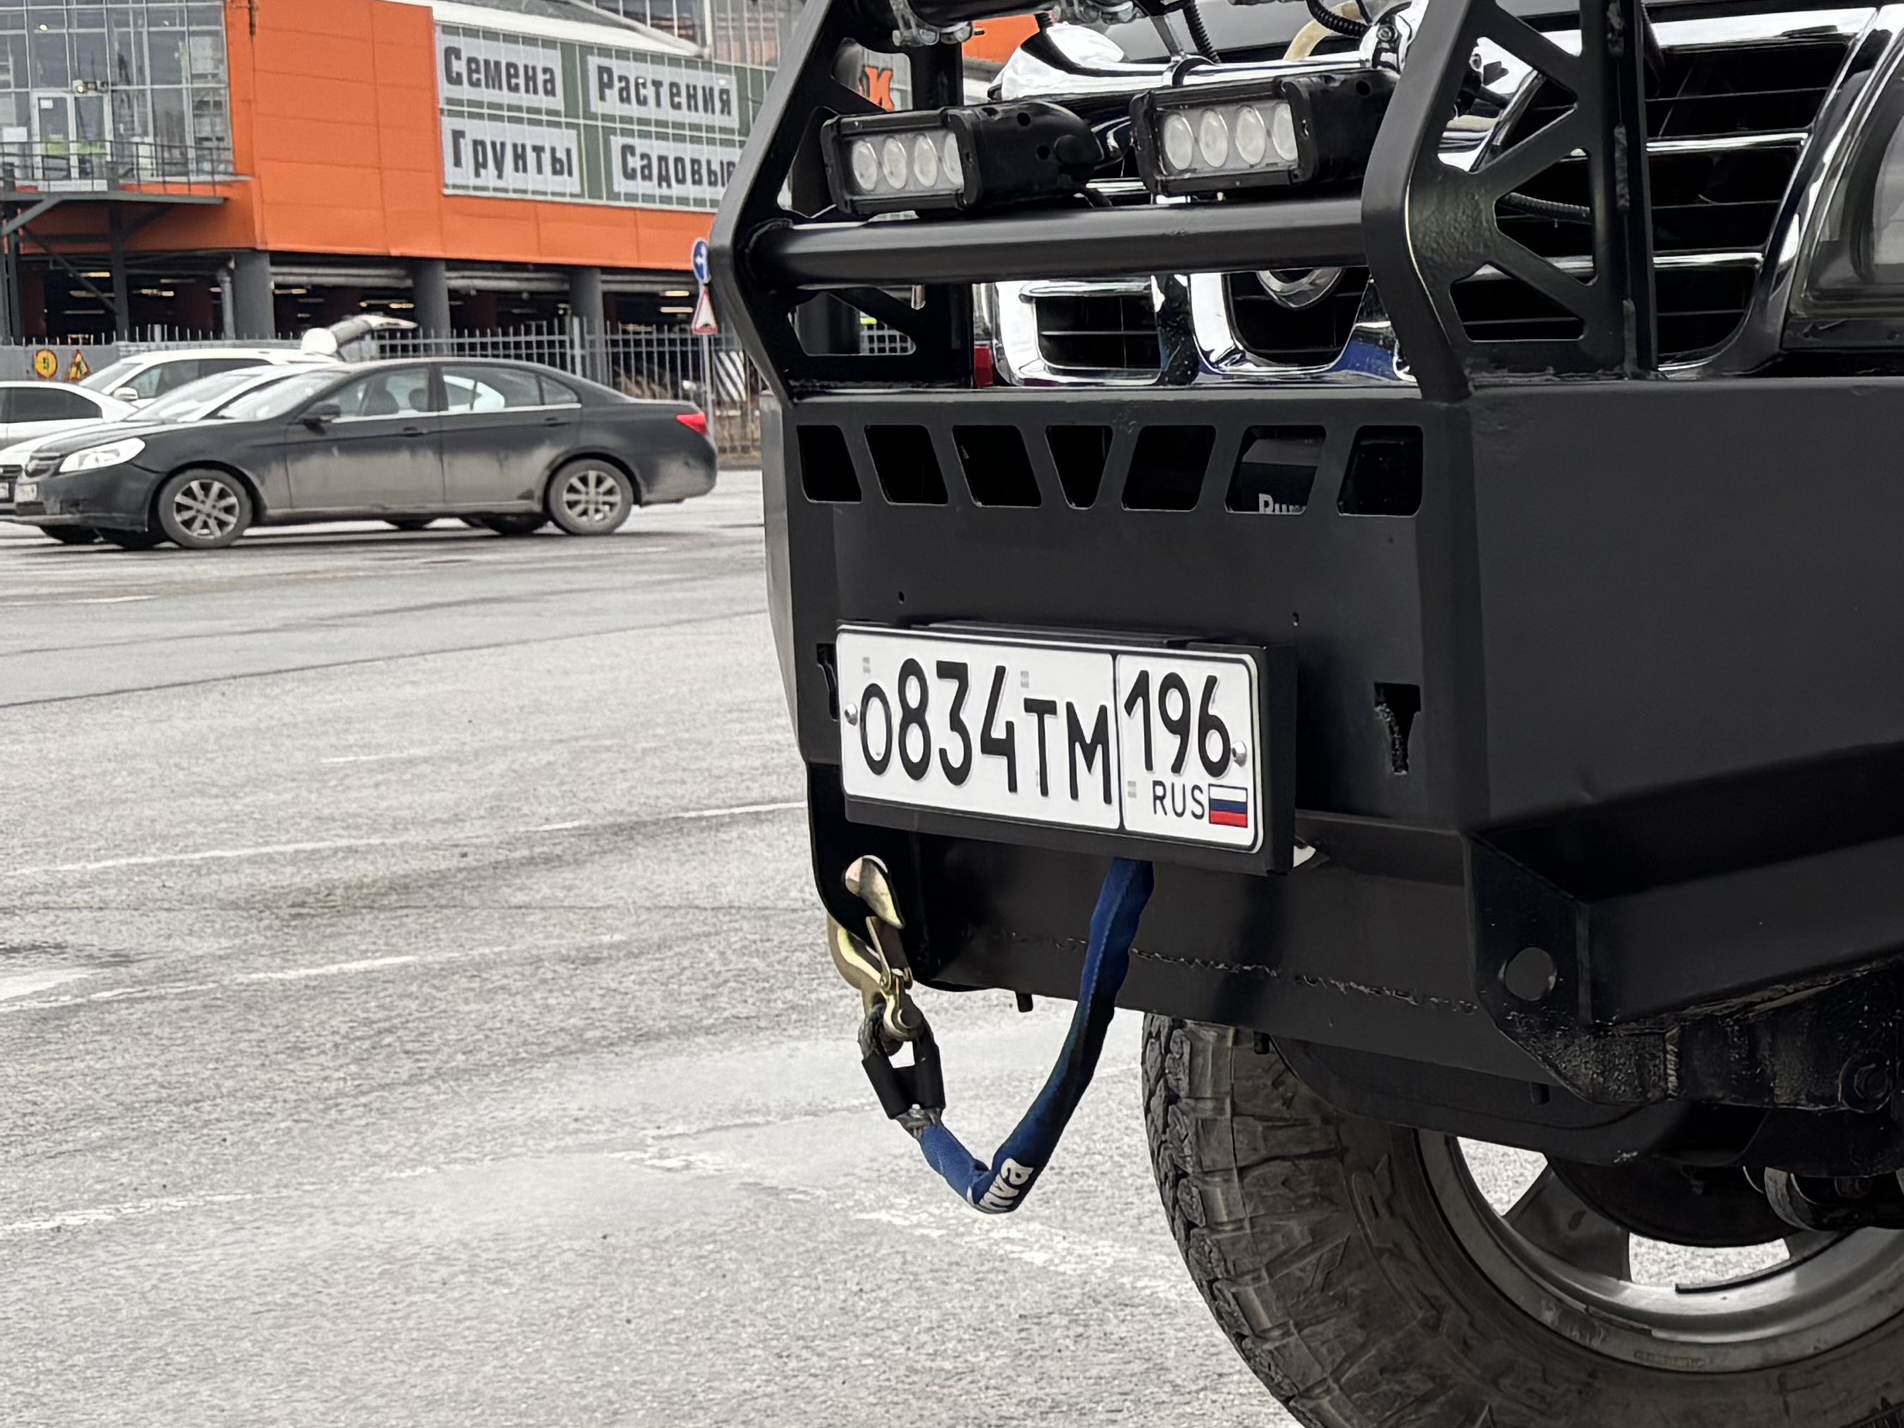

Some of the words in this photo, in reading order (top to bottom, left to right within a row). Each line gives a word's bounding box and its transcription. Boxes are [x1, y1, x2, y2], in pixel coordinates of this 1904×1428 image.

[444, 46, 557, 98] Семена
[597, 65, 732, 116] Растения
[450, 129, 574, 180] Грунты
[1124, 669, 1231, 778] 196
[1152, 780, 1205, 821] RUS
